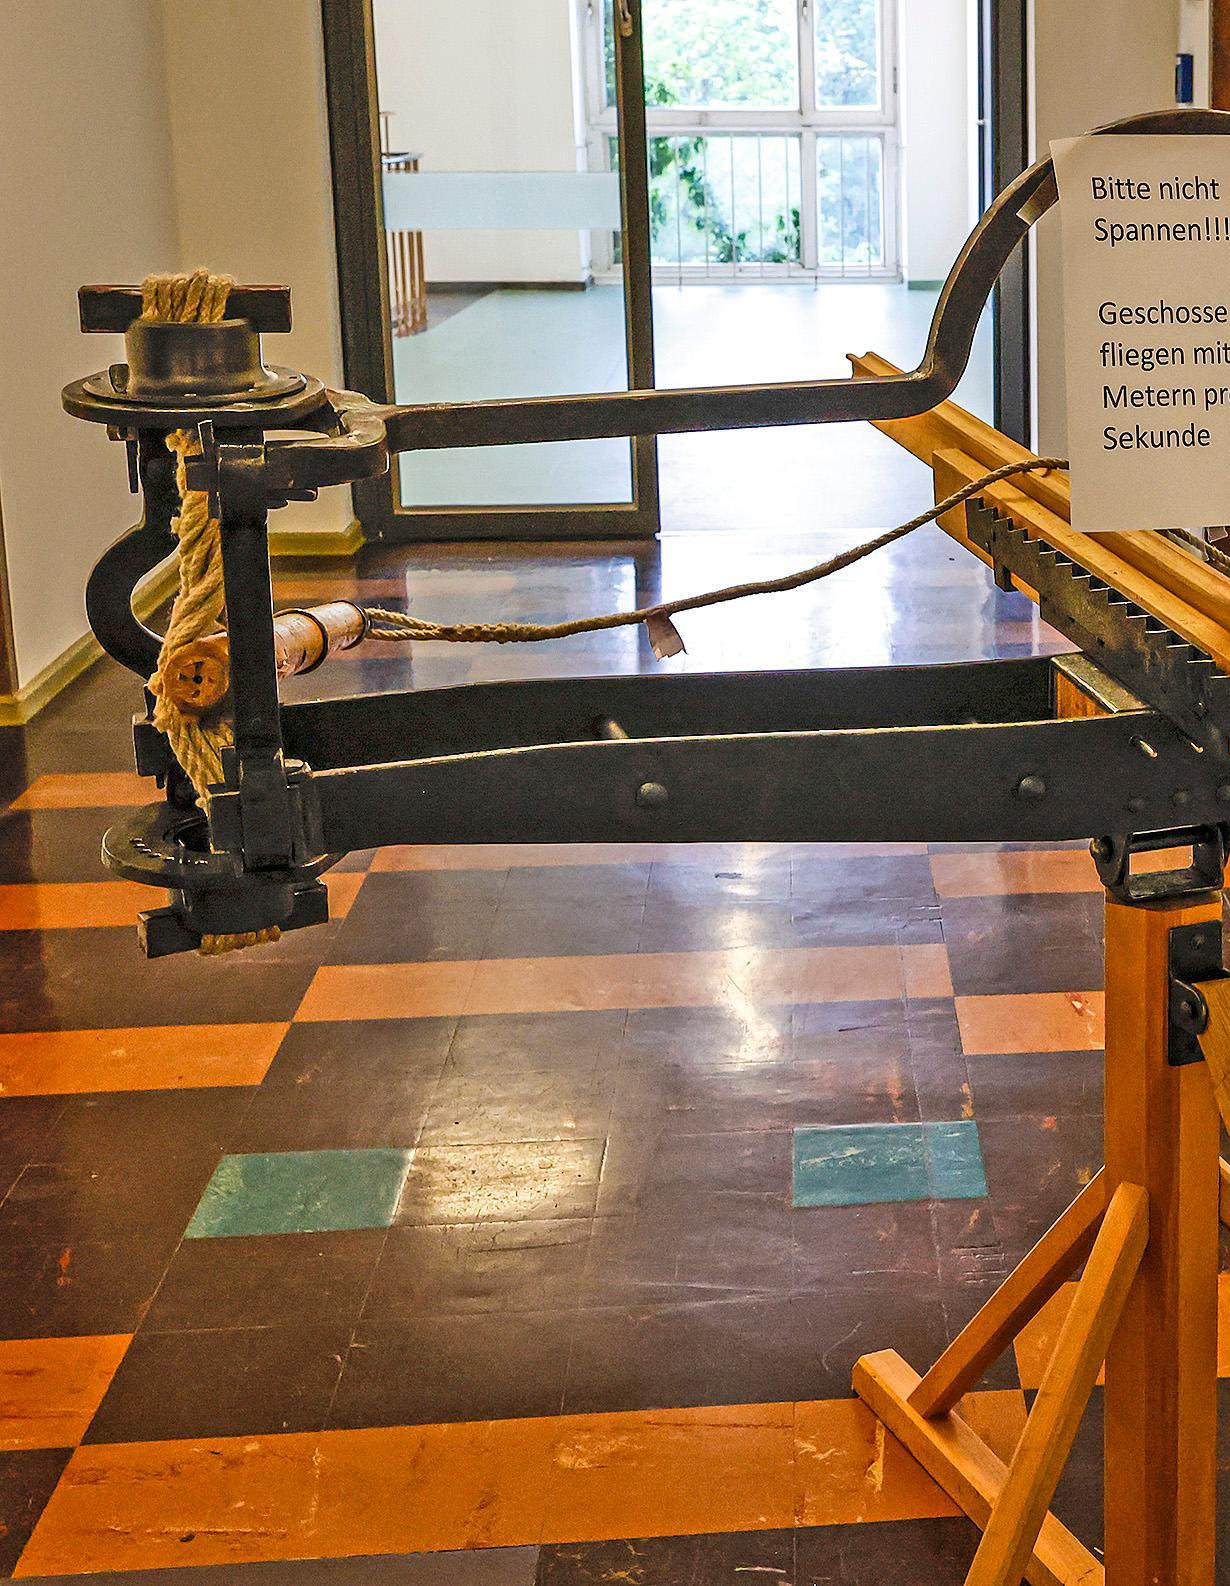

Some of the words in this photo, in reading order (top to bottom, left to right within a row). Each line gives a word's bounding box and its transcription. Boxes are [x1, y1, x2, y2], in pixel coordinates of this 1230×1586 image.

[1091, 176, 1151, 200] Bitte
[1159, 175, 1221, 200] nicht
[1098, 299, 1228, 325] Geschosse
[1099, 341, 1185, 372] fliegen
[1103, 385, 1196, 409] Metern
[1103, 422, 1211, 451] Sekunde
